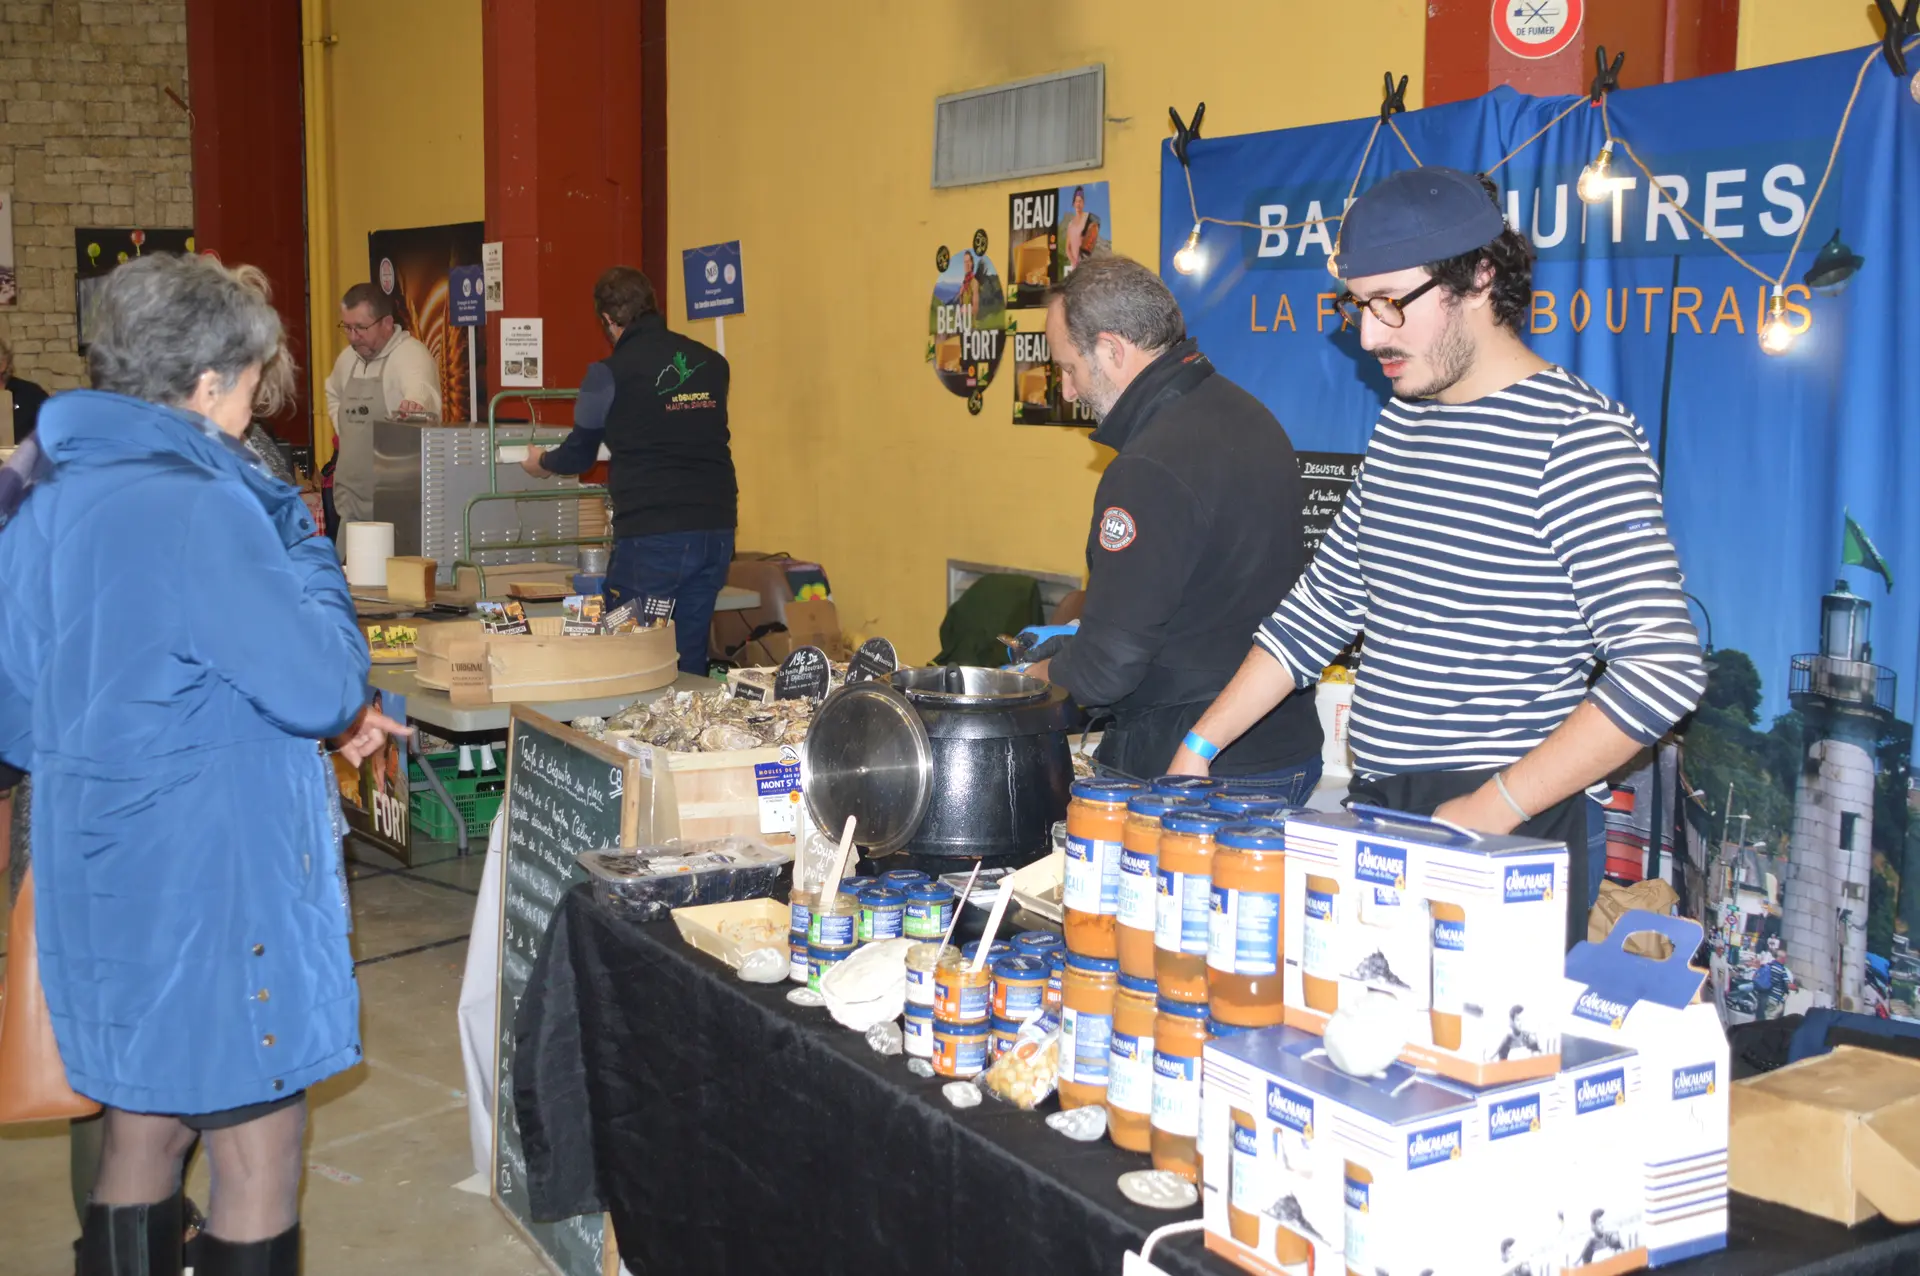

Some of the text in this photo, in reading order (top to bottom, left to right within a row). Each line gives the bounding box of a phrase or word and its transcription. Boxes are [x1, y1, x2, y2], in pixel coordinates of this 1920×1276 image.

[1516, 26, 1555, 36] DE FUMER
[1013, 194, 1055, 230] BEAU
[937, 304, 973, 334] BEAU
[1251, 294, 1297, 332] LA
[1530, 284, 1813, 335] BOUTRAIS
[962, 329, 999, 361] FORT
[1015, 334, 1051, 362] BEAU
[1304, 462, 1345, 476] DEGUSTER
[1106, 518, 1126, 536] HH
[609, 767, 622, 789] CB
[758, 768, 783, 776] MOULES
[587, 778, 605, 805] place
[761, 780, 785, 790] MONT
[372, 789, 407, 846] FORT
[1357, 851, 1404, 874] CANCALAISE
[1506, 873, 1552, 891] CANCALAISE
[1579, 994, 1628, 1017] CANCALAISE
[1577, 1077, 1623, 1102] CANCALAISE
[1674, 1070, 1714, 1089] CANCALAISE
[1268, 1092, 1312, 1123] CANCALAISE
[1490, 1103, 1538, 1129] CANCALAISE
[1409, 1130, 1460, 1157] CANCALAISE
